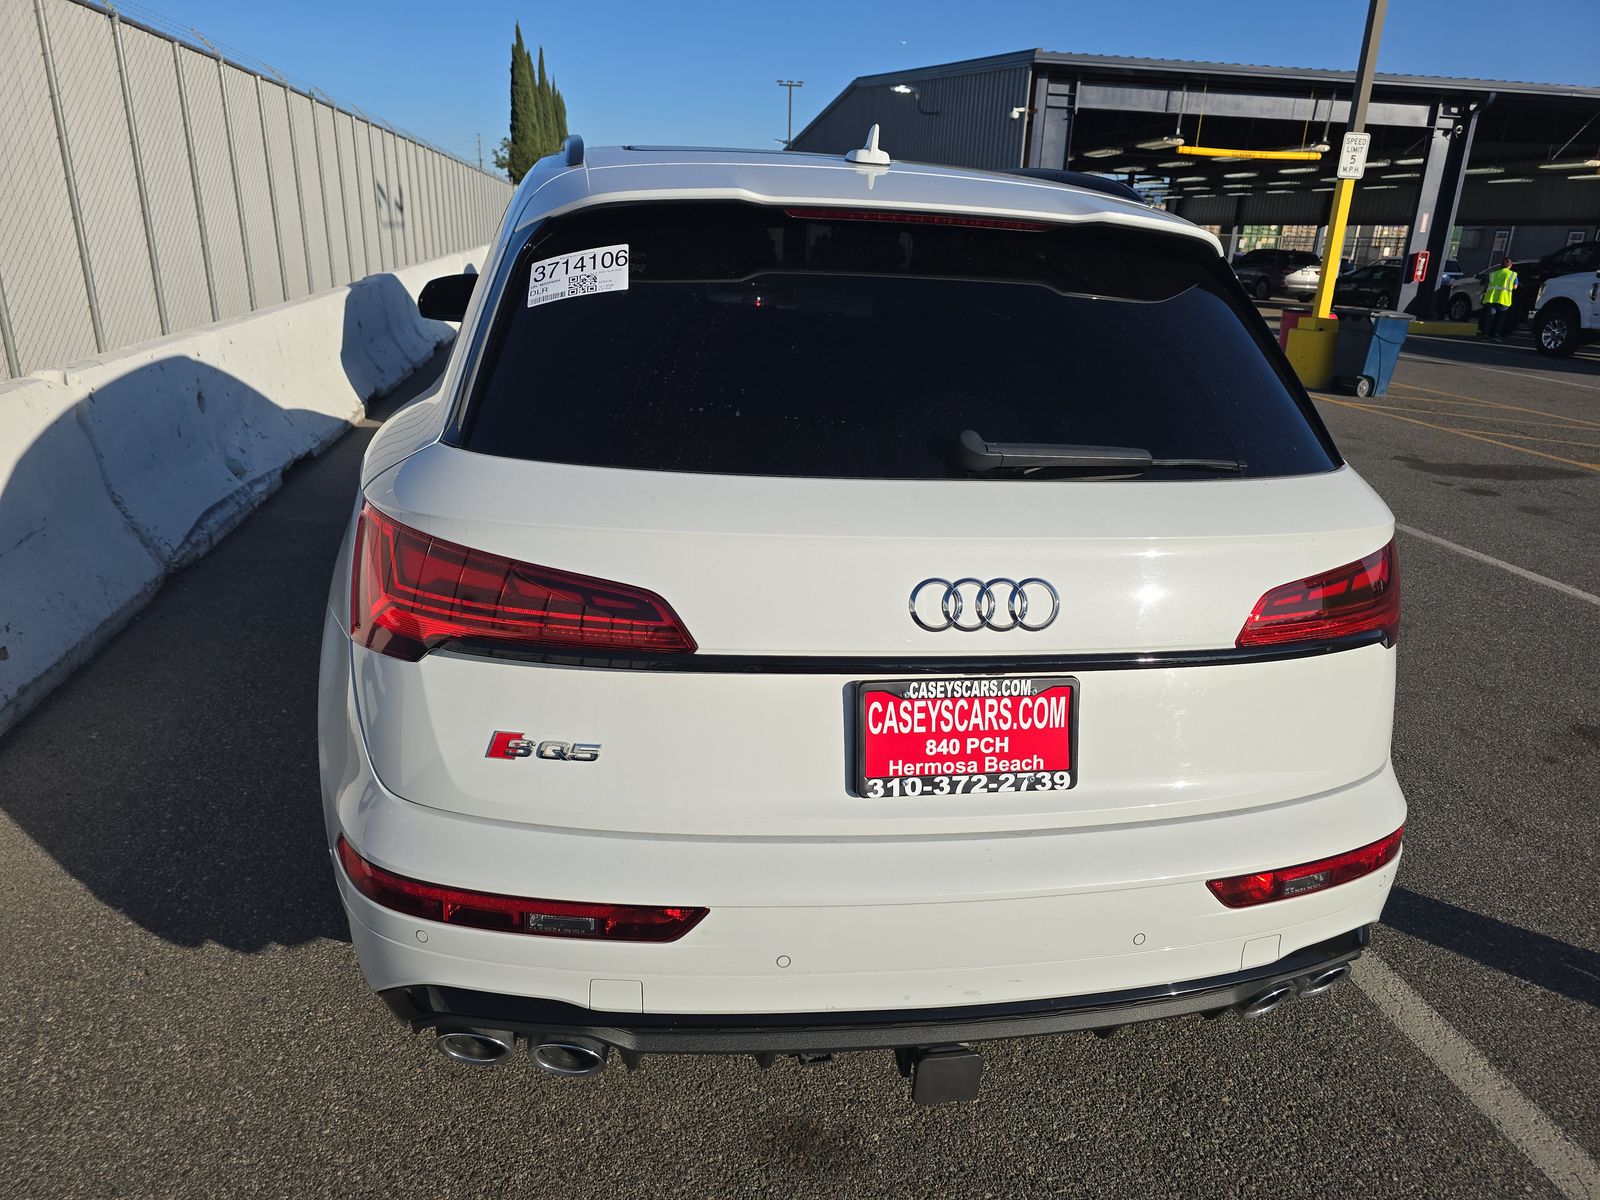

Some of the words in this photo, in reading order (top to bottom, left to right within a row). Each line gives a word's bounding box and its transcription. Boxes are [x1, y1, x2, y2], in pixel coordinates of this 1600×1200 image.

[1345, 137, 1366, 145] SPEED
[1349, 154, 1356, 164] 5
[533, 250, 628, 282] 3714106
[529, 287, 548, 297] DLR
[909, 680, 1032, 699] CASEYSCARS.COM
[868, 696, 1066, 735] CASEYSCARS.COM
[504, 738, 602, 762] SQ5
[925, 738, 960, 756] 840
[966, 736, 1009, 754] PCH
[888, 759, 978, 776] Hermosa
[984, 754, 1044, 773] Beach
[866, 771, 1071, 799] 310-372-2739
